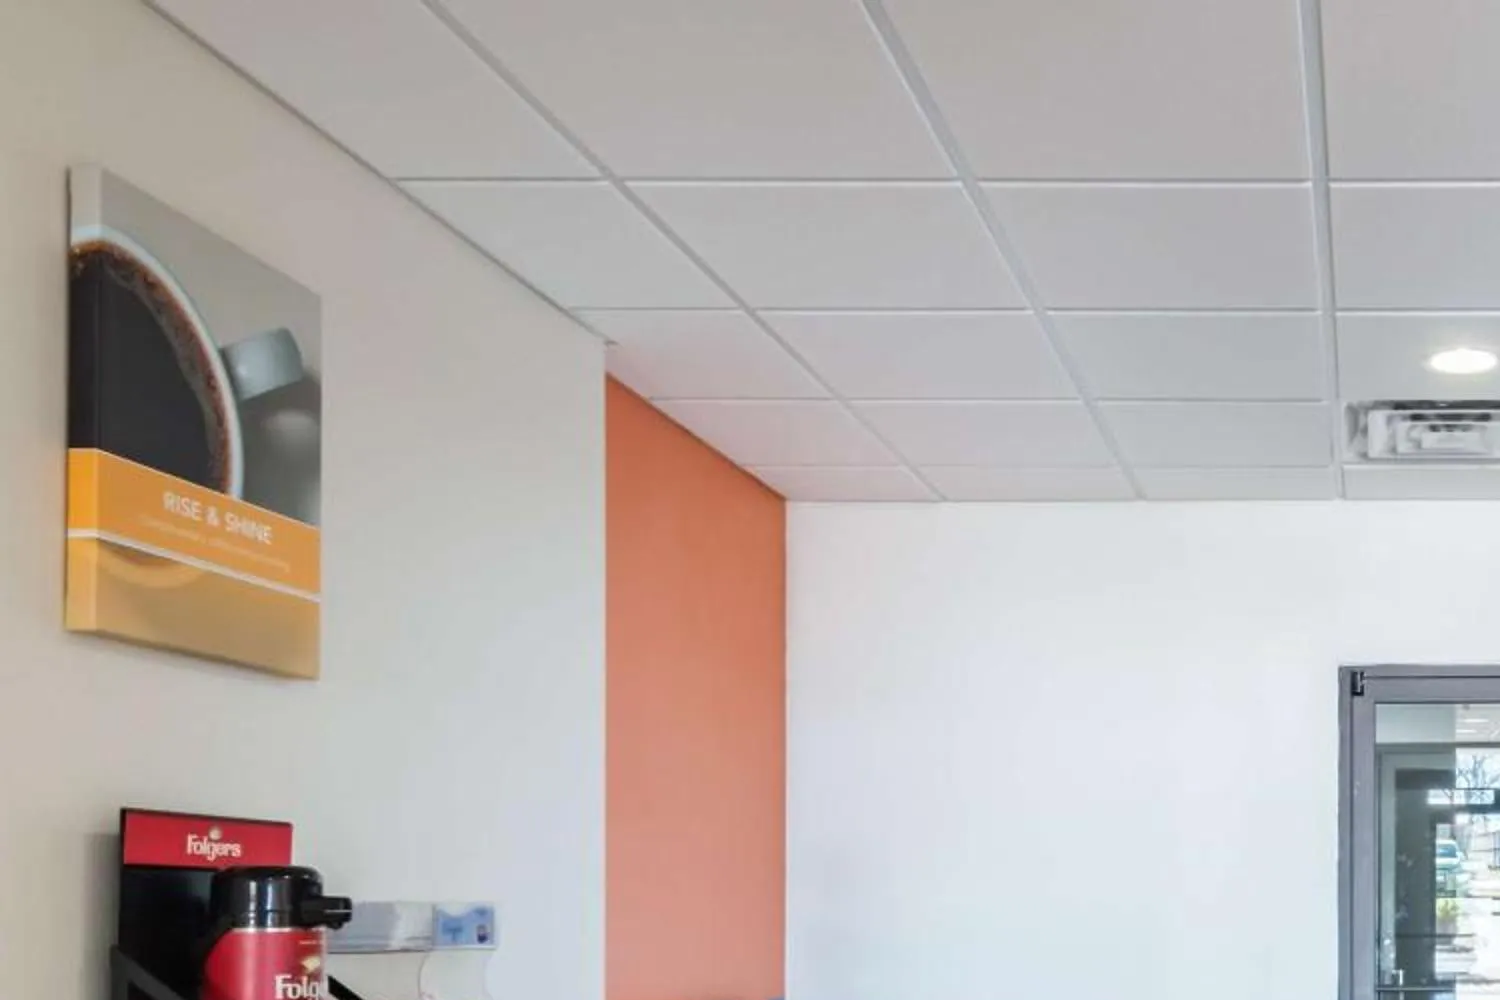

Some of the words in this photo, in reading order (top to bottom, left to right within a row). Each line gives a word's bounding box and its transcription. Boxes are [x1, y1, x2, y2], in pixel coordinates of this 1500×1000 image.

[163, 491, 203, 521] RISE
[206, 506, 220, 527] &
[224, 511, 273, 545] SHINE
[186, 833, 241, 861] Folgers
